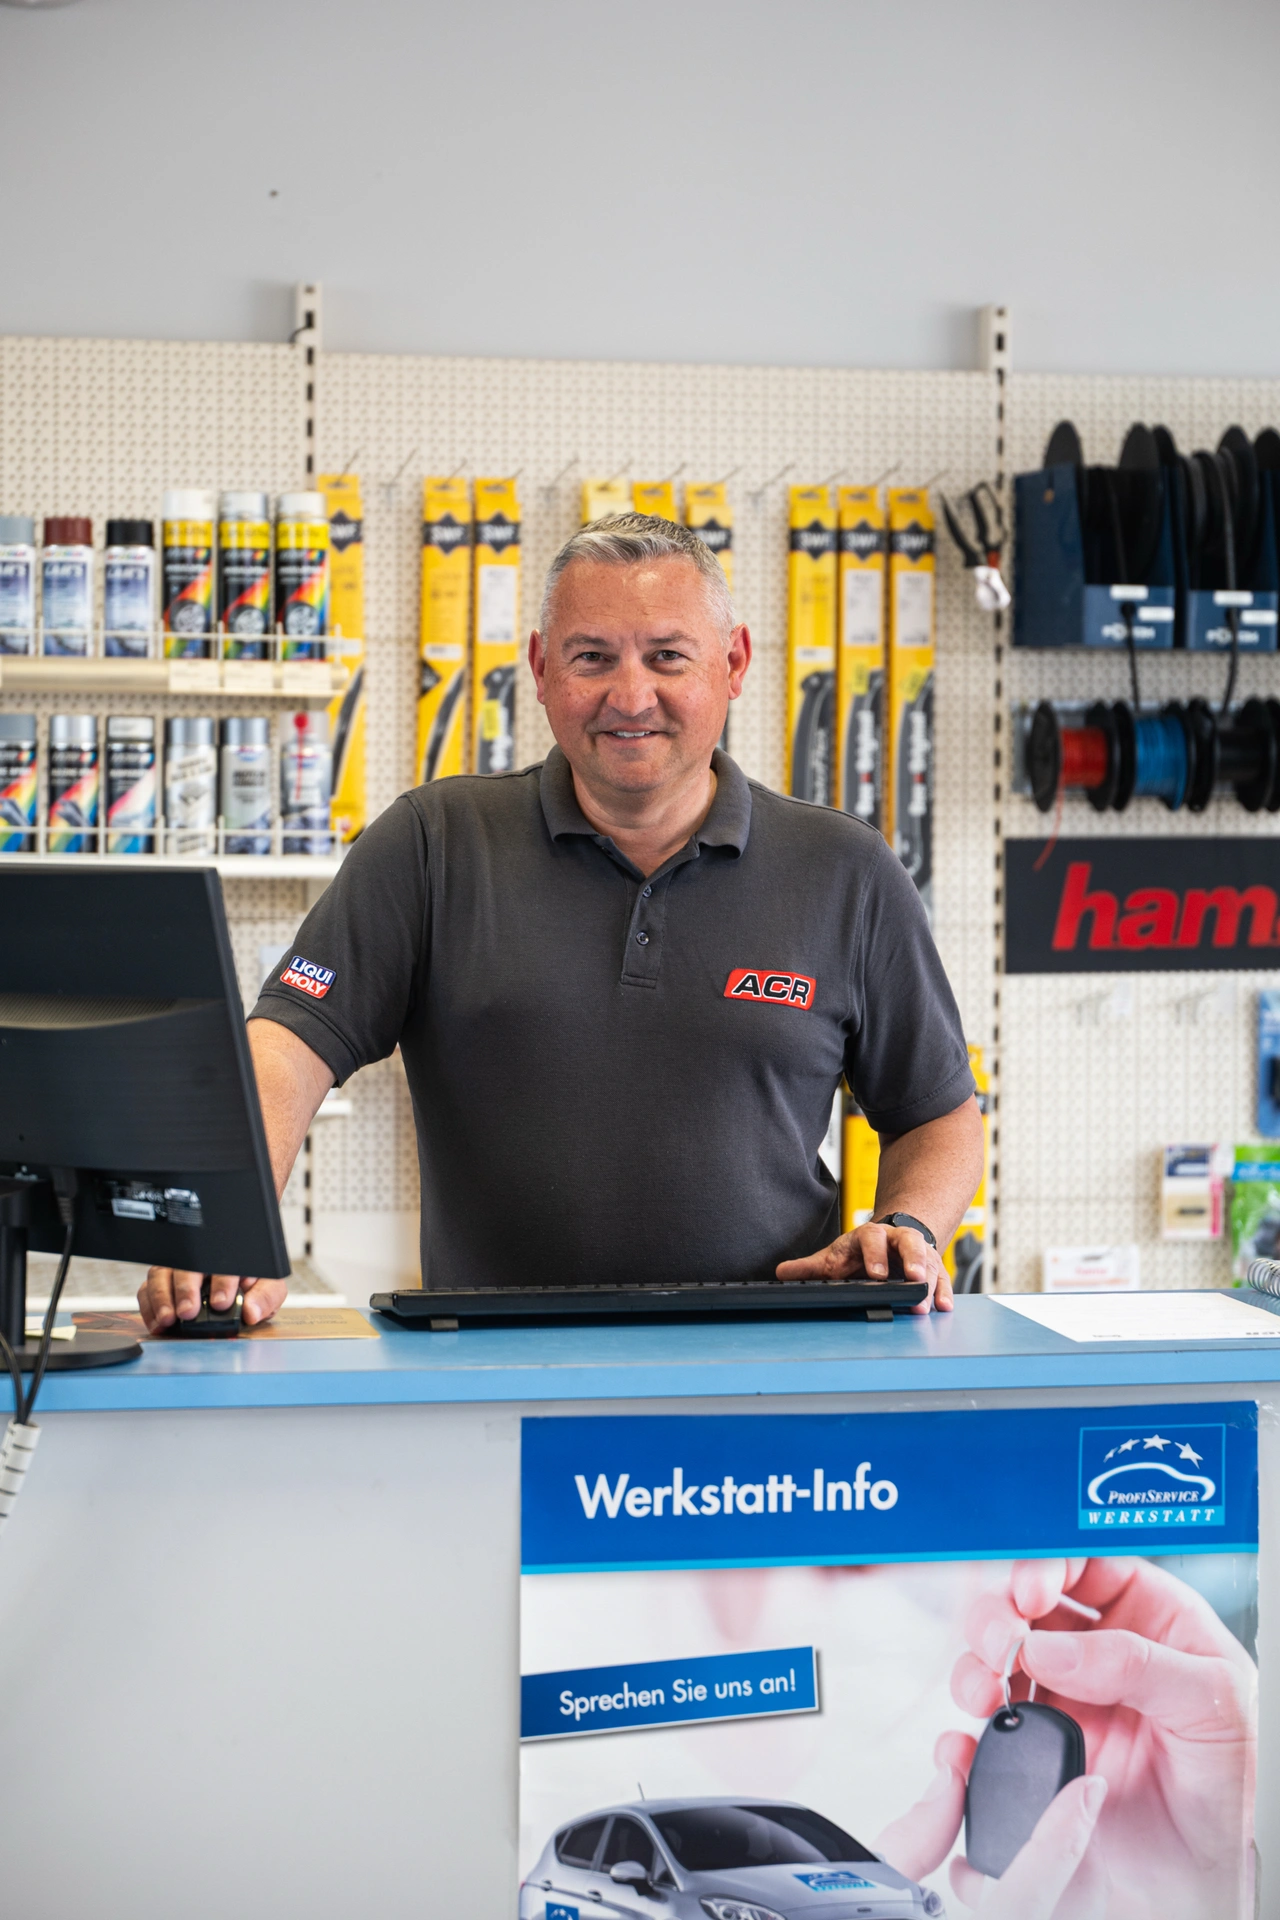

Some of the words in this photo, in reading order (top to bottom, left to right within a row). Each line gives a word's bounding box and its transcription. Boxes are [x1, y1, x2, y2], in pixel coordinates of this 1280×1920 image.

[431, 525, 464, 542] SWF
[481, 524, 515, 541] SWF
[1053, 861, 1280, 950] ham
[283, 969, 327, 995] MOLY
[290, 957, 333, 984] LIQUI
[731, 972, 811, 1006] ACR
[574, 1461, 899, 1519] Werkstatt-Info
[1088, 1508, 1215, 1525] WERKSTATT
[559, 1681, 665, 1721] Sprechen
[672, 1678, 708, 1703] Sie
[714, 1680, 753, 1699] uns
[759, 1668, 796, 1694] an!
